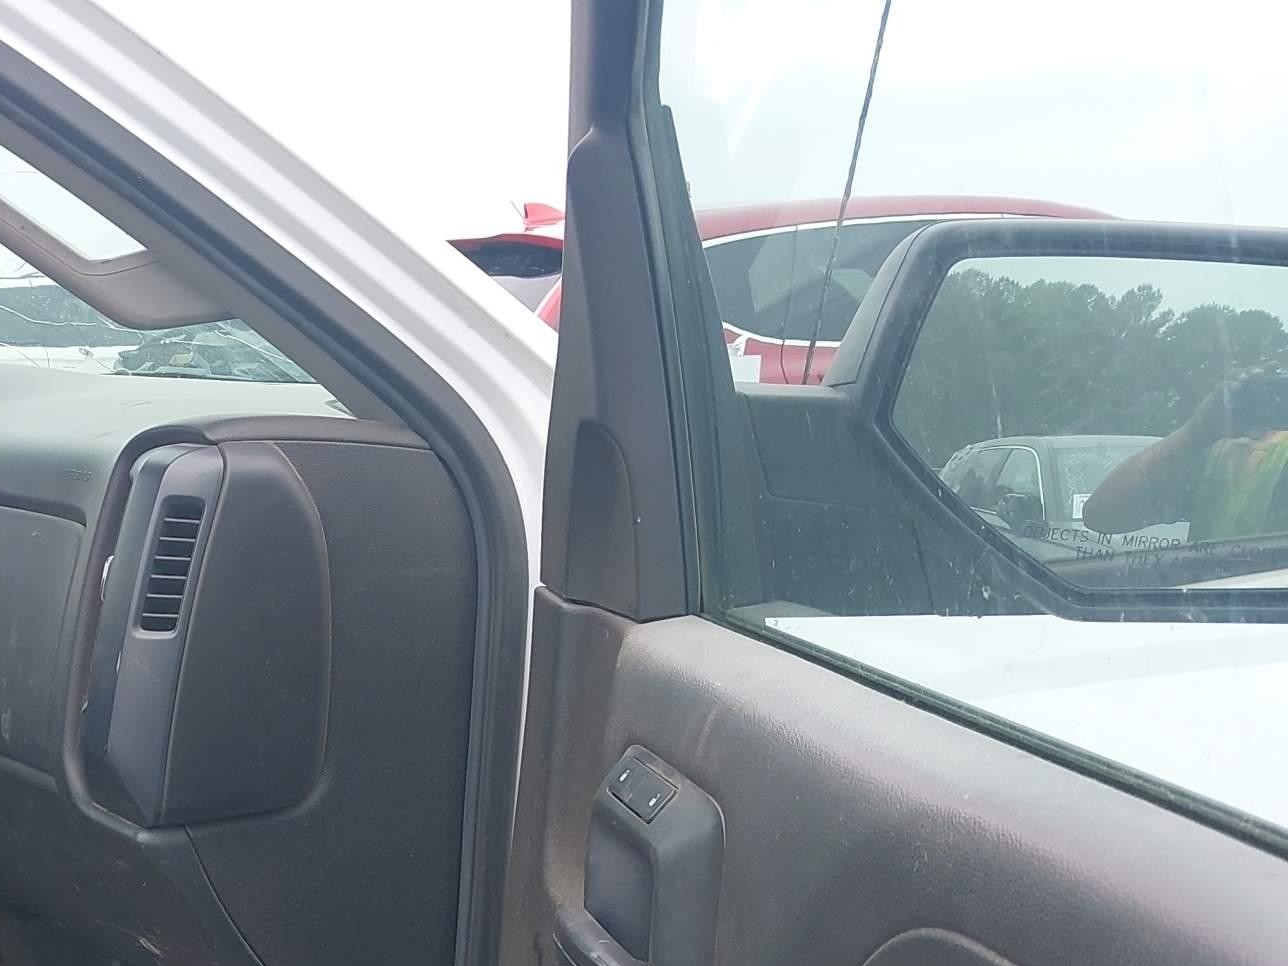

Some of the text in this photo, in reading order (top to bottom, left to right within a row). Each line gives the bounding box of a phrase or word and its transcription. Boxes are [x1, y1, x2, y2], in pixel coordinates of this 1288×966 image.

[1075, 545, 1115, 562] THAN
[1097, 532, 1112, 545] IN
[1122, 534, 1180, 552] MIRROR
[1189, 541, 1217, 556] ARE
